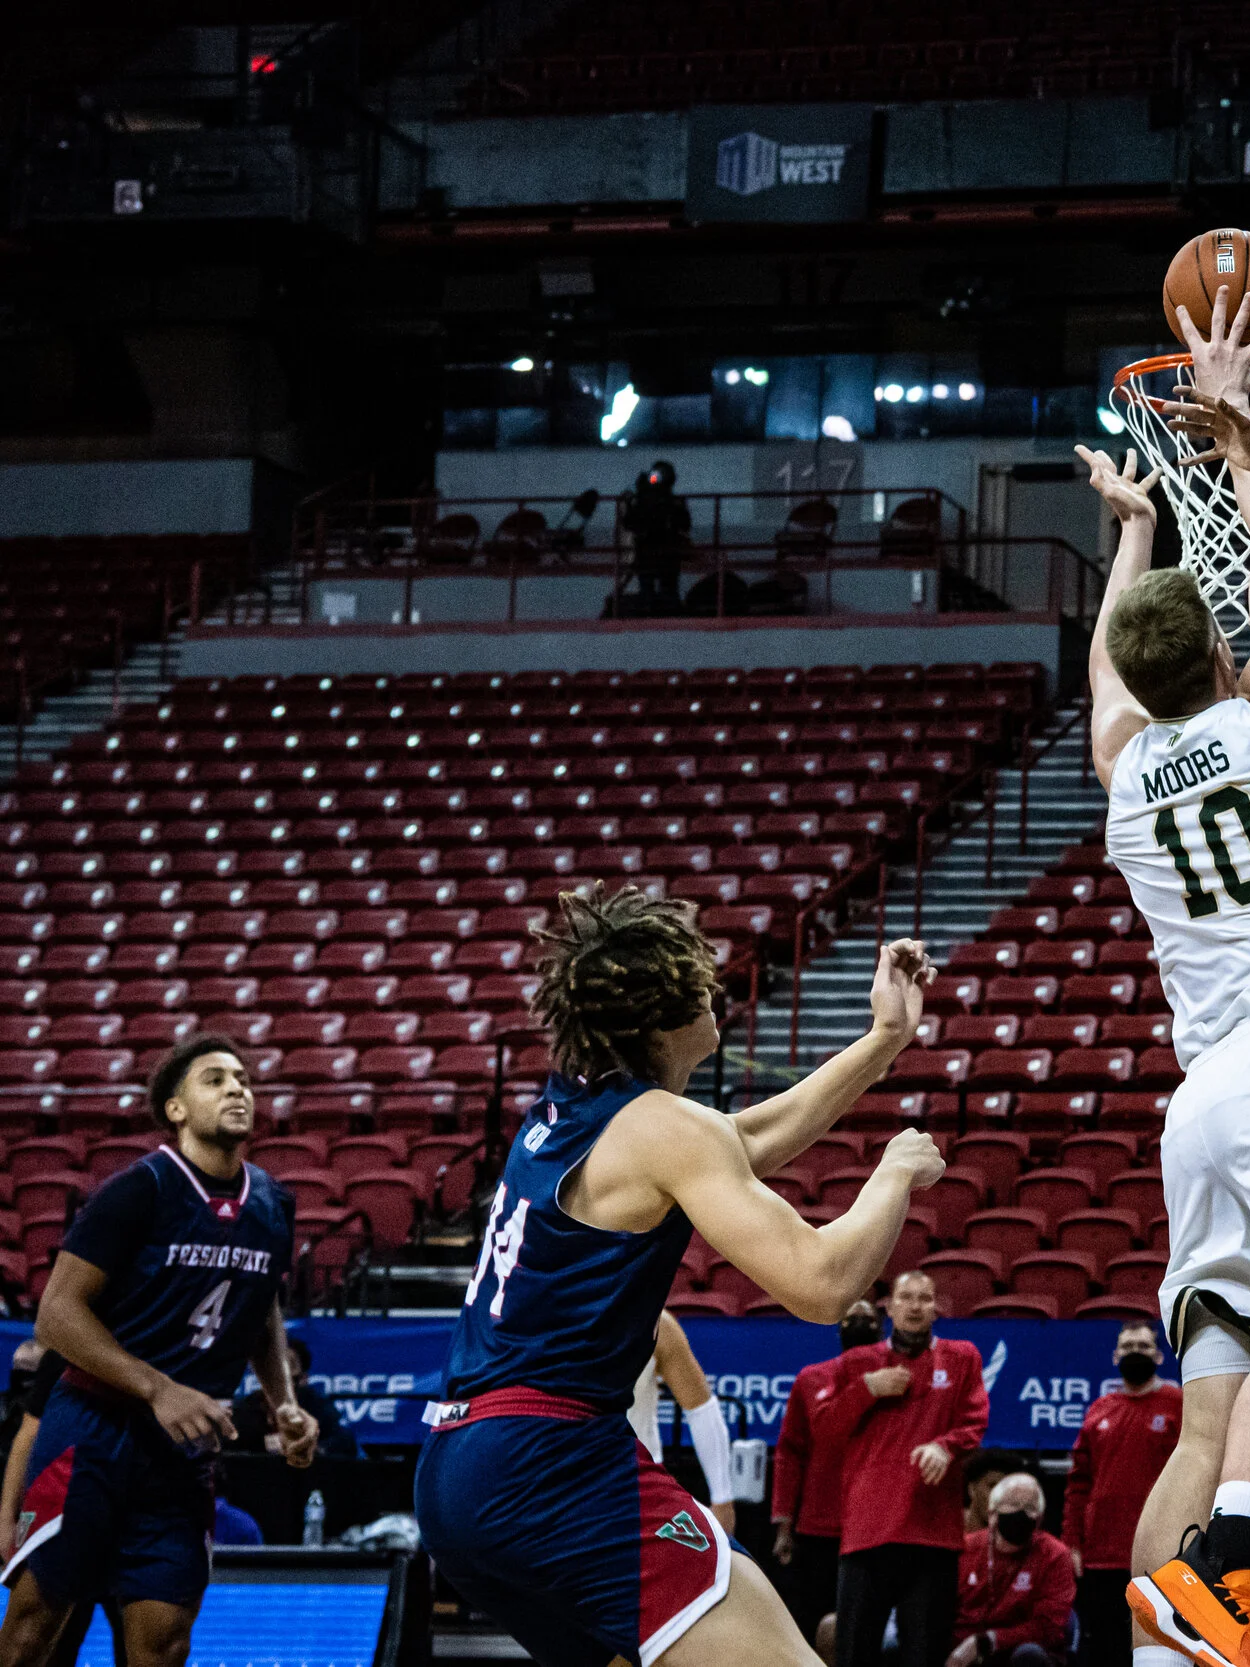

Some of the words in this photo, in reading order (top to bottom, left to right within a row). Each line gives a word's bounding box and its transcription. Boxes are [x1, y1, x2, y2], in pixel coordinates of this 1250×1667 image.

[779, 159, 845, 185] WEST
[1141, 740, 1230, 804] MOORS
[165, 1243, 230, 1269] FRESNO
[230, 1246, 273, 1275] STATE
[187, 1279, 233, 1350] 4
[1018, 1376, 1091, 1402] AIR
